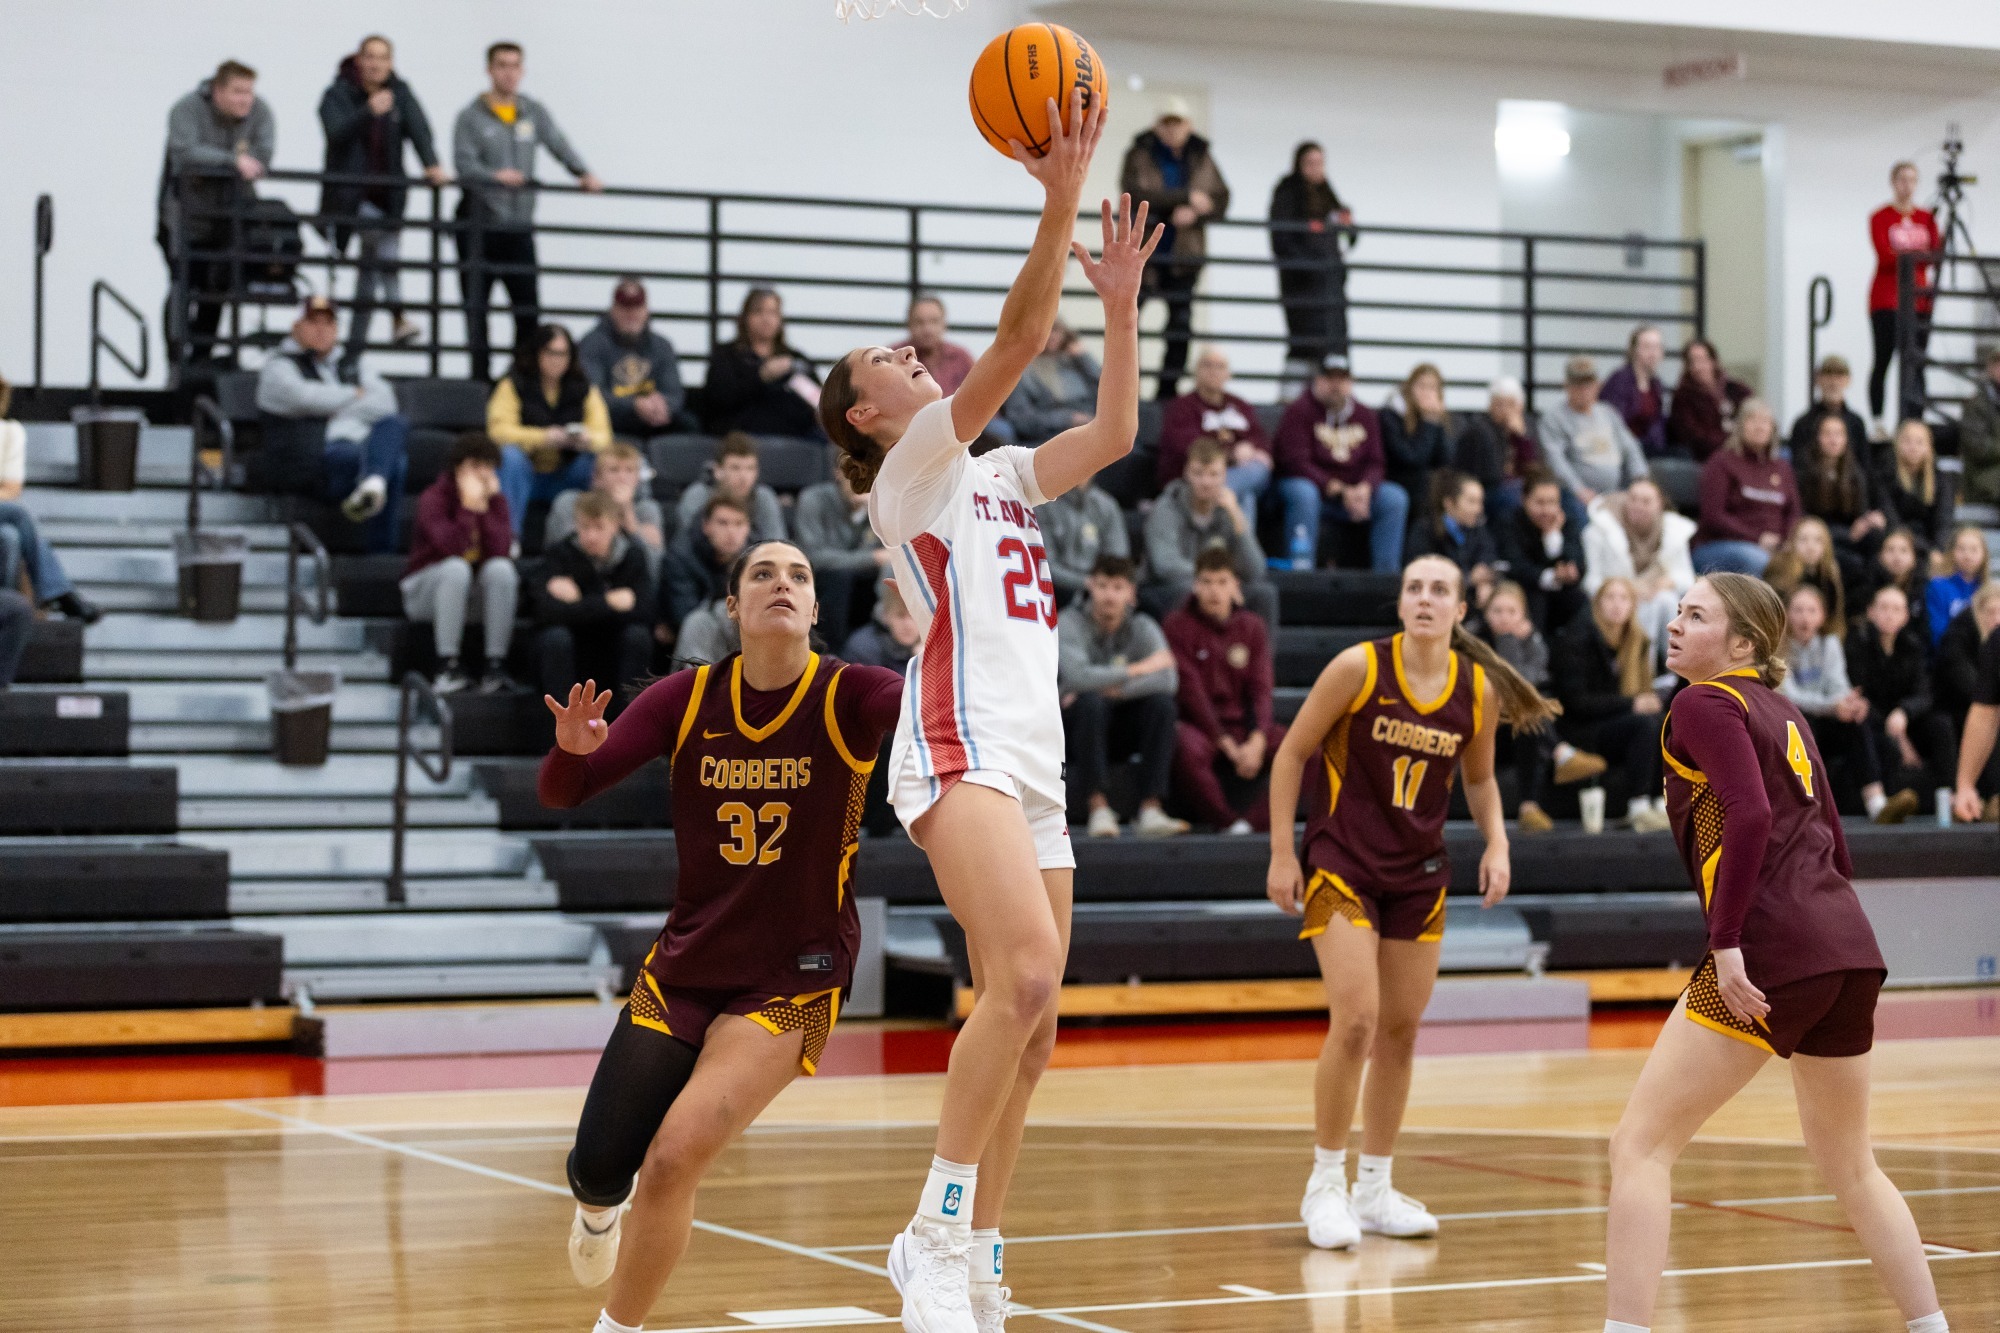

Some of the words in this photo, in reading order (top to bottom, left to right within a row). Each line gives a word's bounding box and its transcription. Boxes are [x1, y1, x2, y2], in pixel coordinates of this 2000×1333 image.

[1028, 44, 1039, 72] NFHS
[996, 534, 1059, 632] 25
[1371, 714, 1463, 758] COBBERS
[1786, 720, 1814, 797] 4
[700, 755, 812, 789] COBBERS
[1391, 754, 1429, 811] 11
[716, 801, 792, 866] 32
